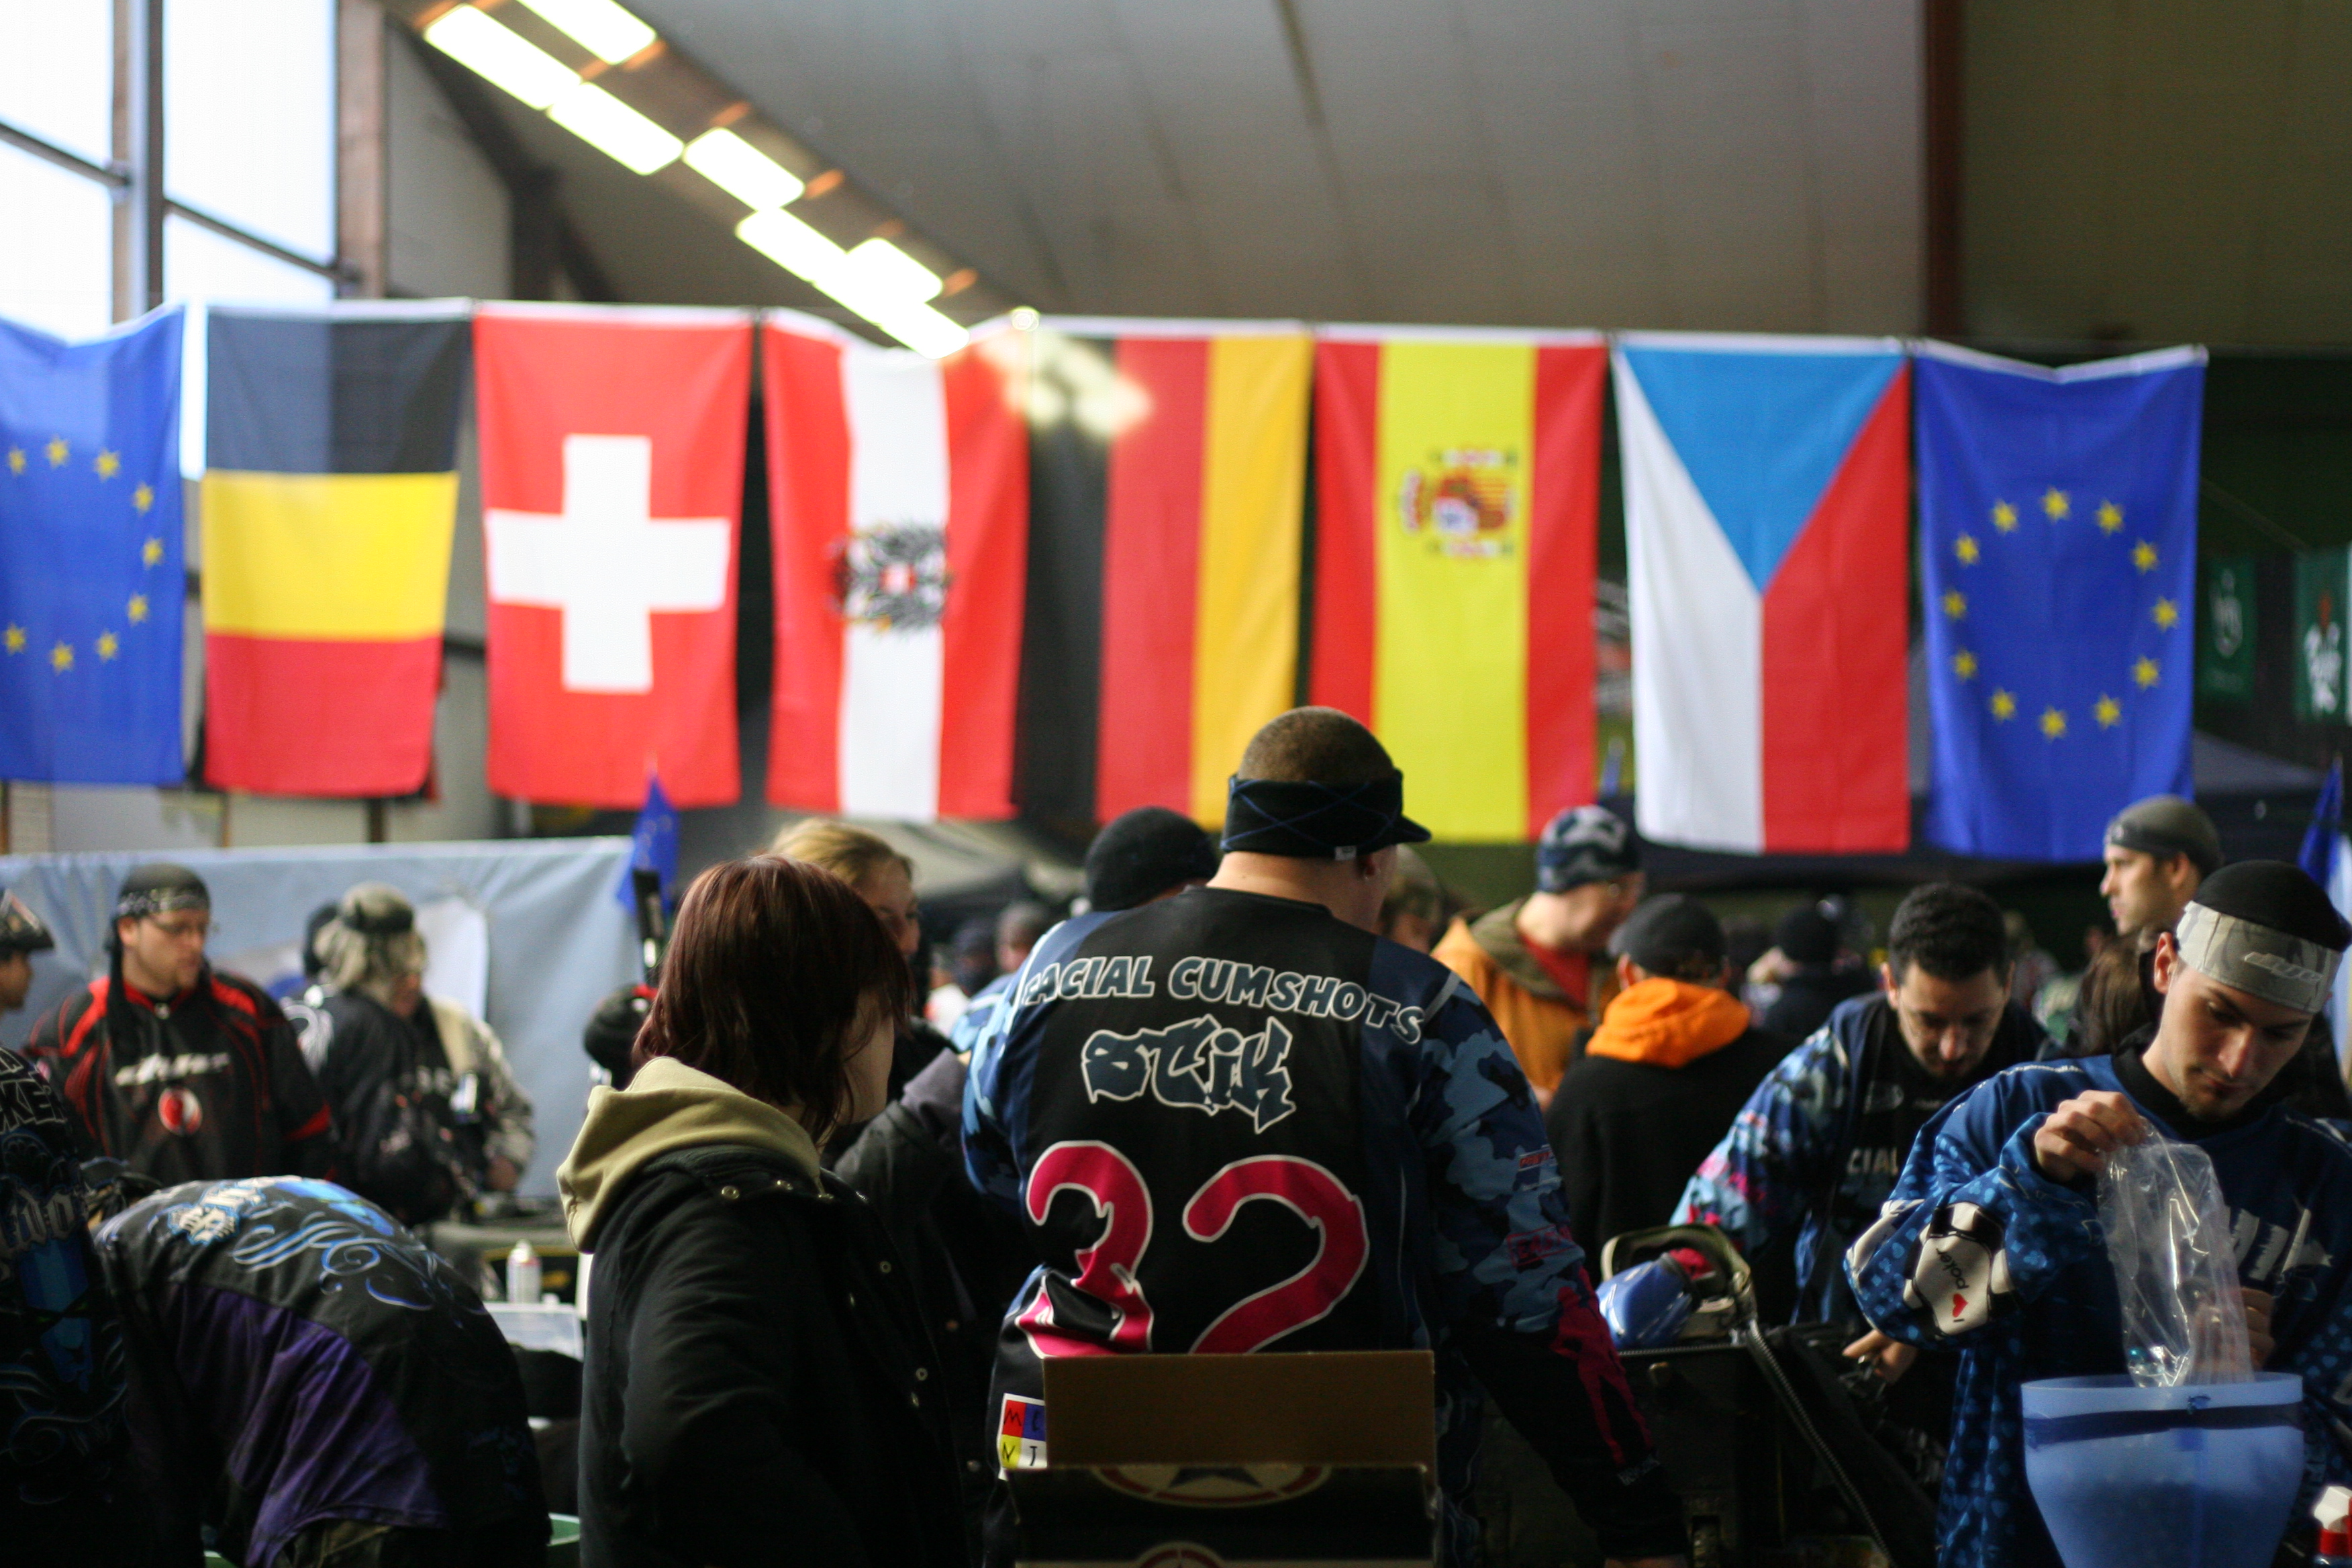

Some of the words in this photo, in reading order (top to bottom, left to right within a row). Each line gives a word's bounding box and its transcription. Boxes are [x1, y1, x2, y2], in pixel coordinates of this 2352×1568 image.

[1168, 957, 1425, 1044] CUMSHOTS
[1014, 1140, 1371, 1359] 32
[1936, 1247, 1969, 1289] poker
